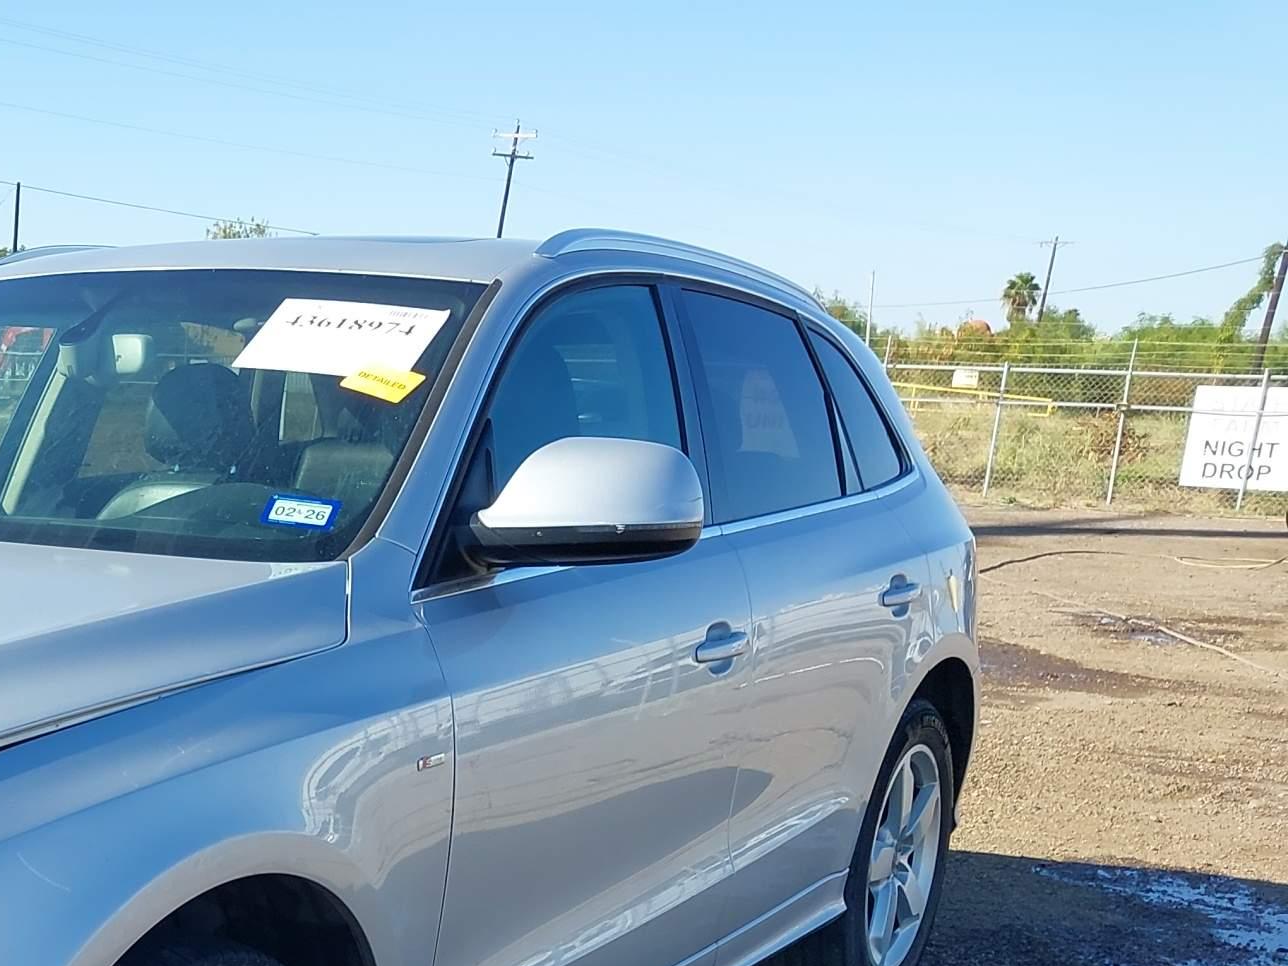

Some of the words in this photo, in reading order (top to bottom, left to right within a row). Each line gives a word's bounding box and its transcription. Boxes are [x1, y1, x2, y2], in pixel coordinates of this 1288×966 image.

[286, 313, 417, 337] 43618974
[358, 370, 407, 391] DETAILED
[1203, 440, 1280, 458] NIGHT
[1202, 462, 1271, 481] DROP
